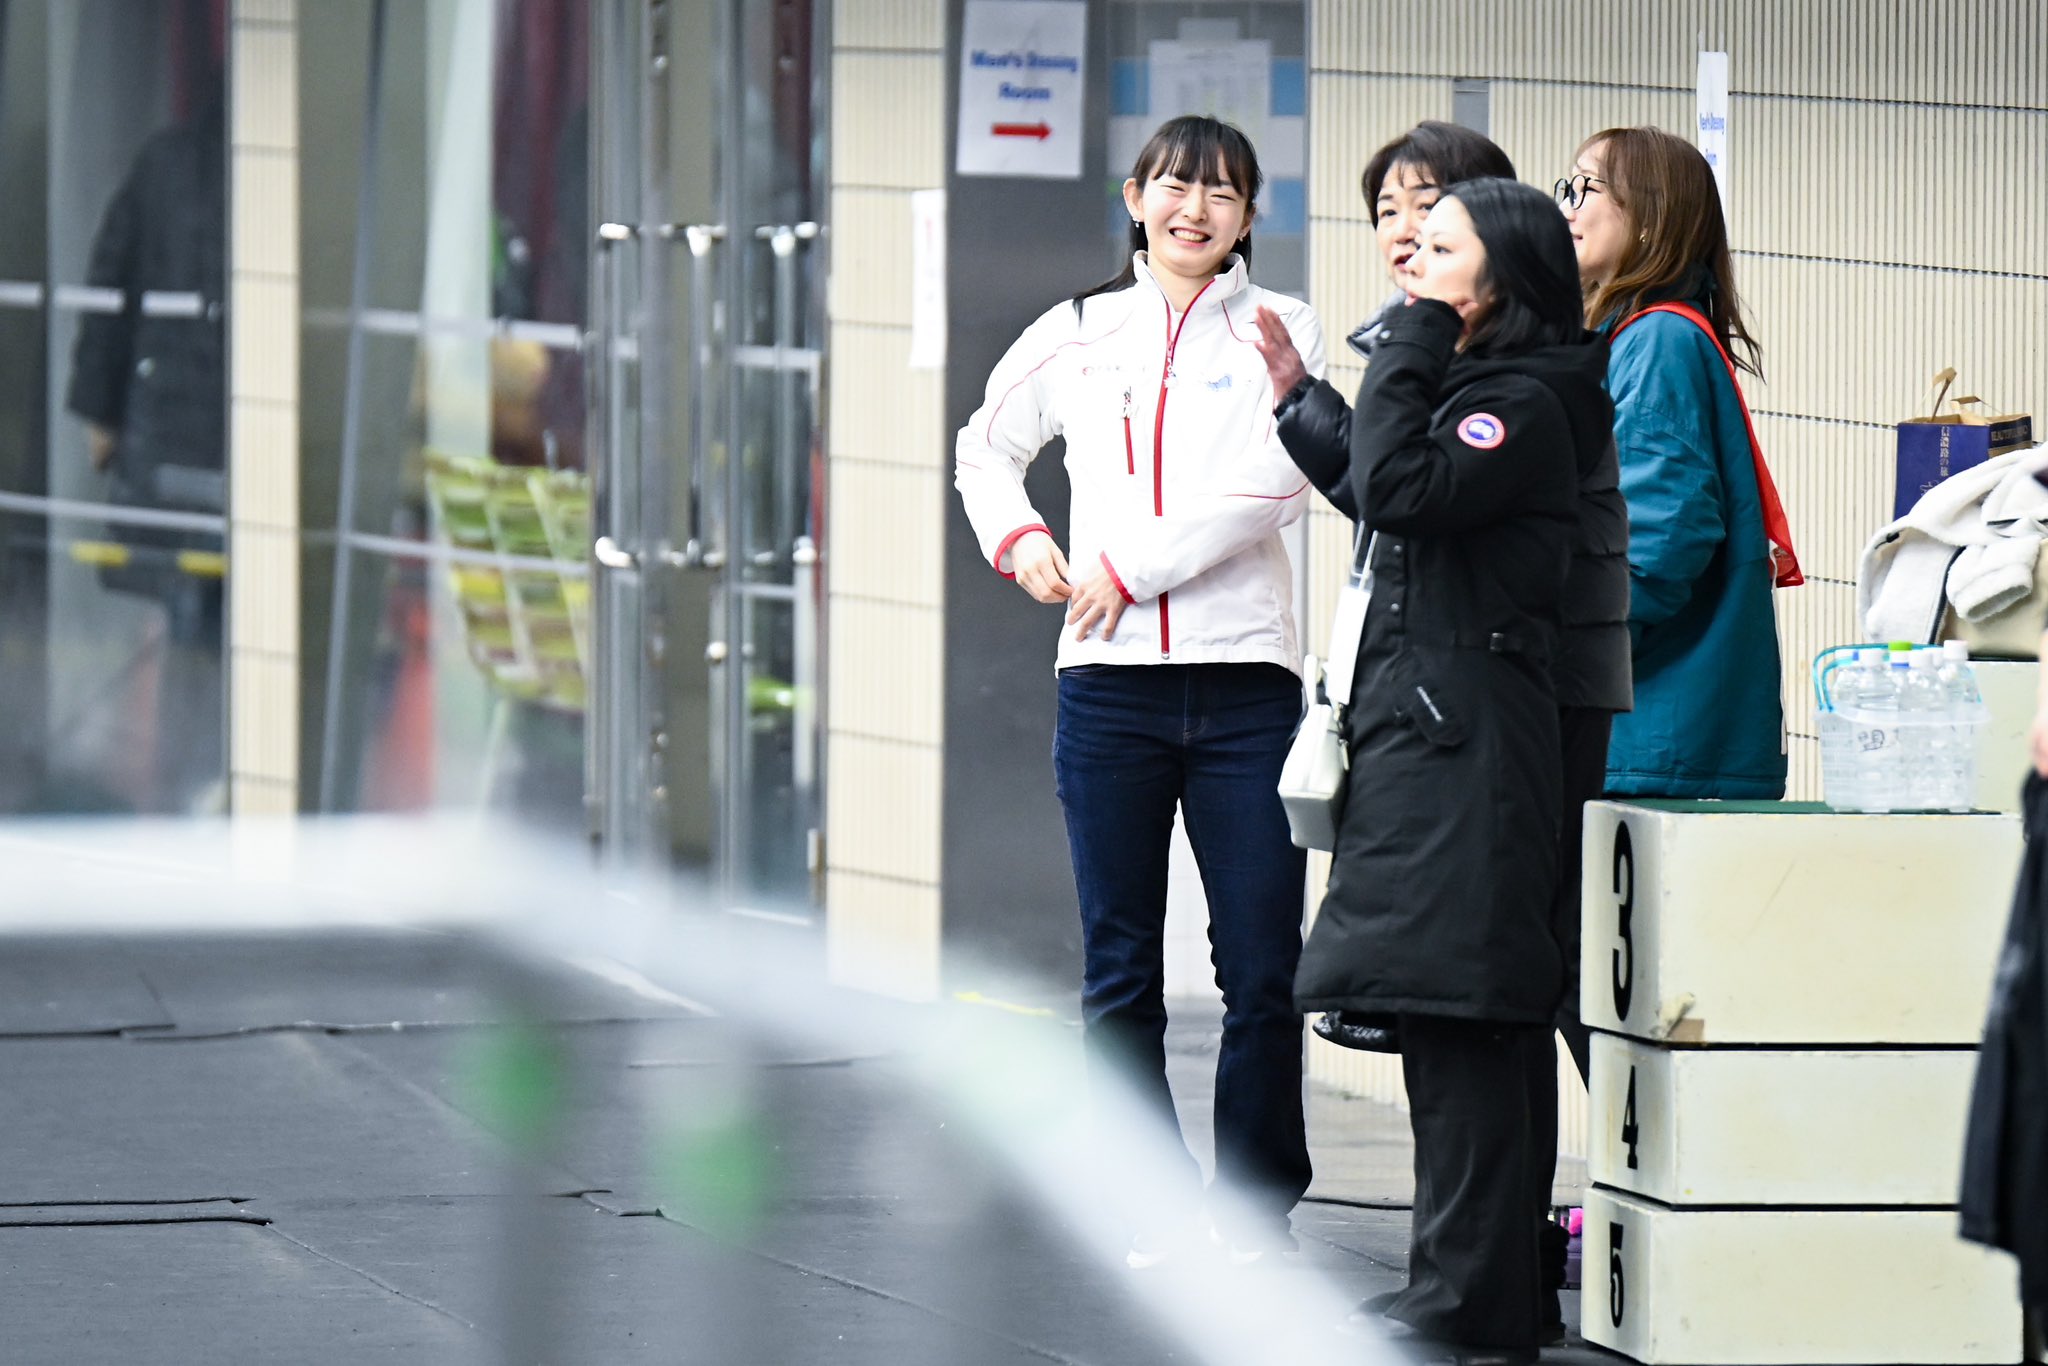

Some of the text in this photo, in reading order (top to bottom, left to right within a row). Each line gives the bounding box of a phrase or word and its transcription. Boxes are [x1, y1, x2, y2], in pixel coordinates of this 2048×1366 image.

[1613, 820, 1634, 1022] 3
[1622, 1065, 1639, 1170] 4
[1610, 1222, 1624, 1328] 5
